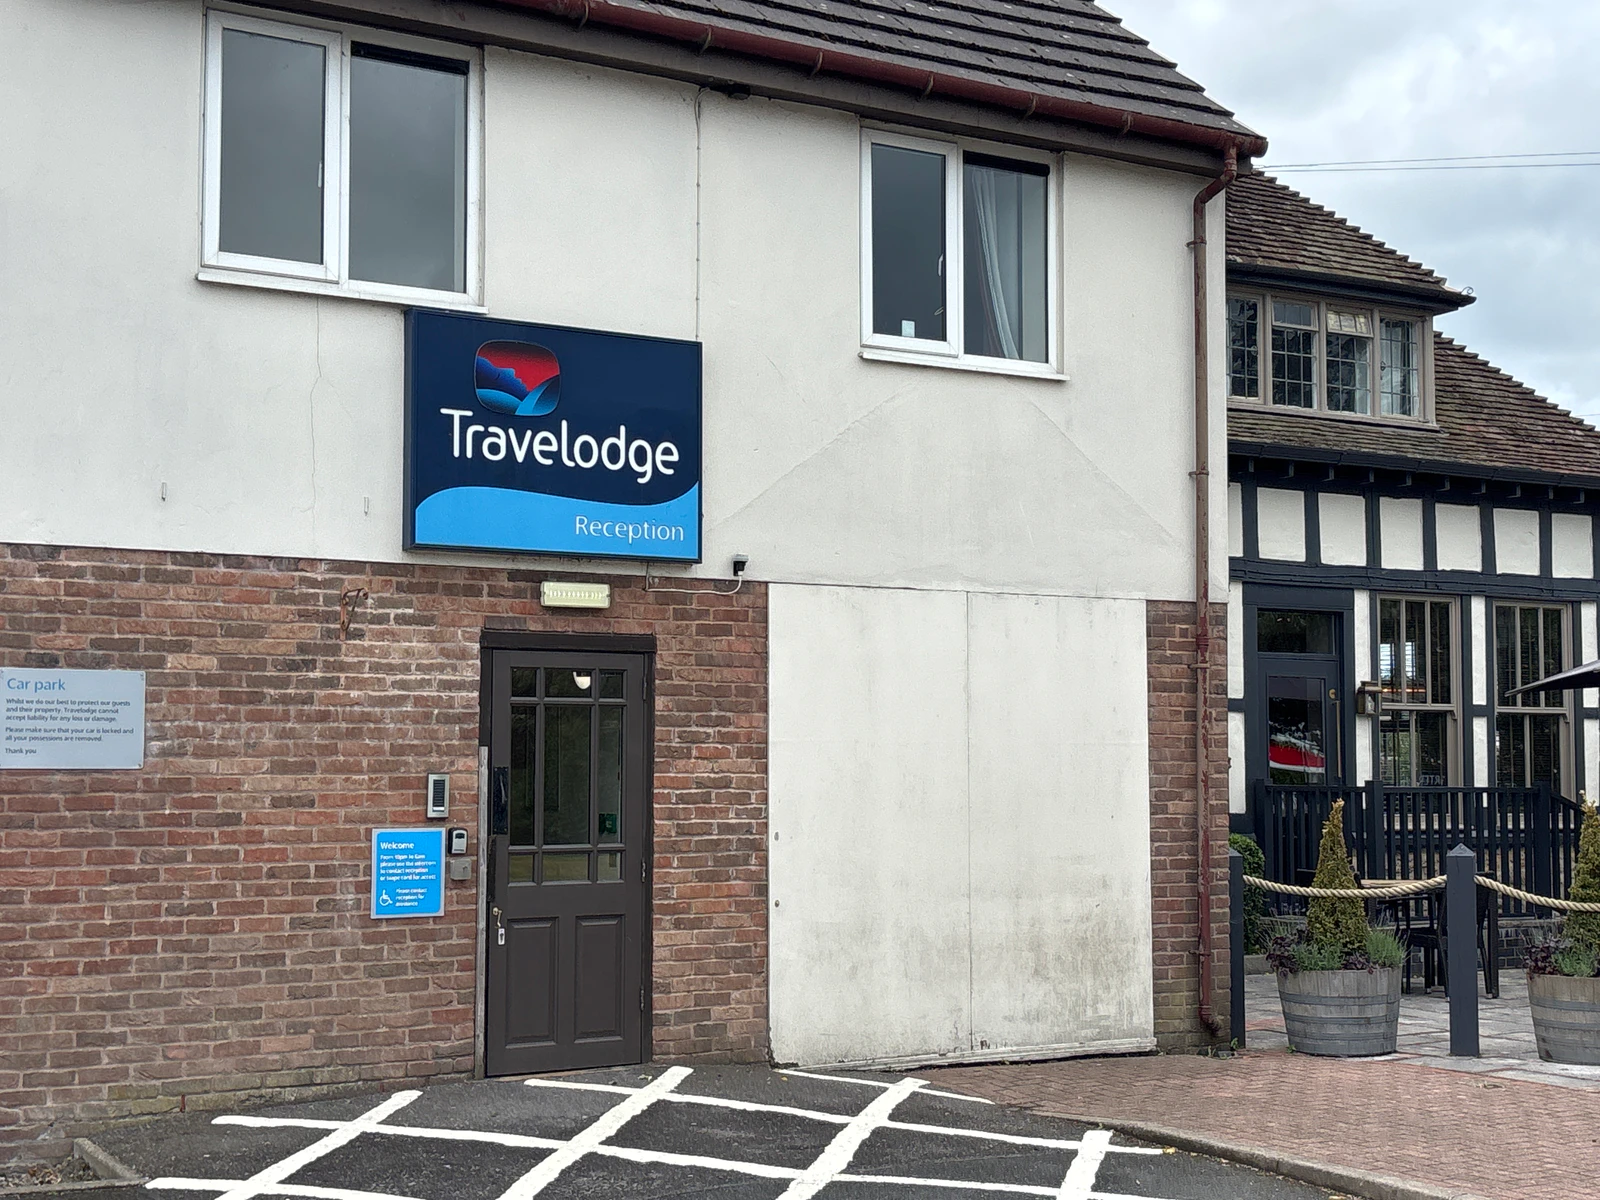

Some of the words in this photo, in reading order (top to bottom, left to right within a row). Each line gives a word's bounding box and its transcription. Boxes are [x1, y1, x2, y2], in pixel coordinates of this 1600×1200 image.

[440, 408, 679, 484] Travelodge
[575, 516, 684, 544] Reception
[7, 678, 31, 690] Car
[34, 678, 66, 693] park
[64, 707, 97, 715] Travelodge
[27, 714, 48, 722] liability
[380, 841, 414, 849] Welcome
